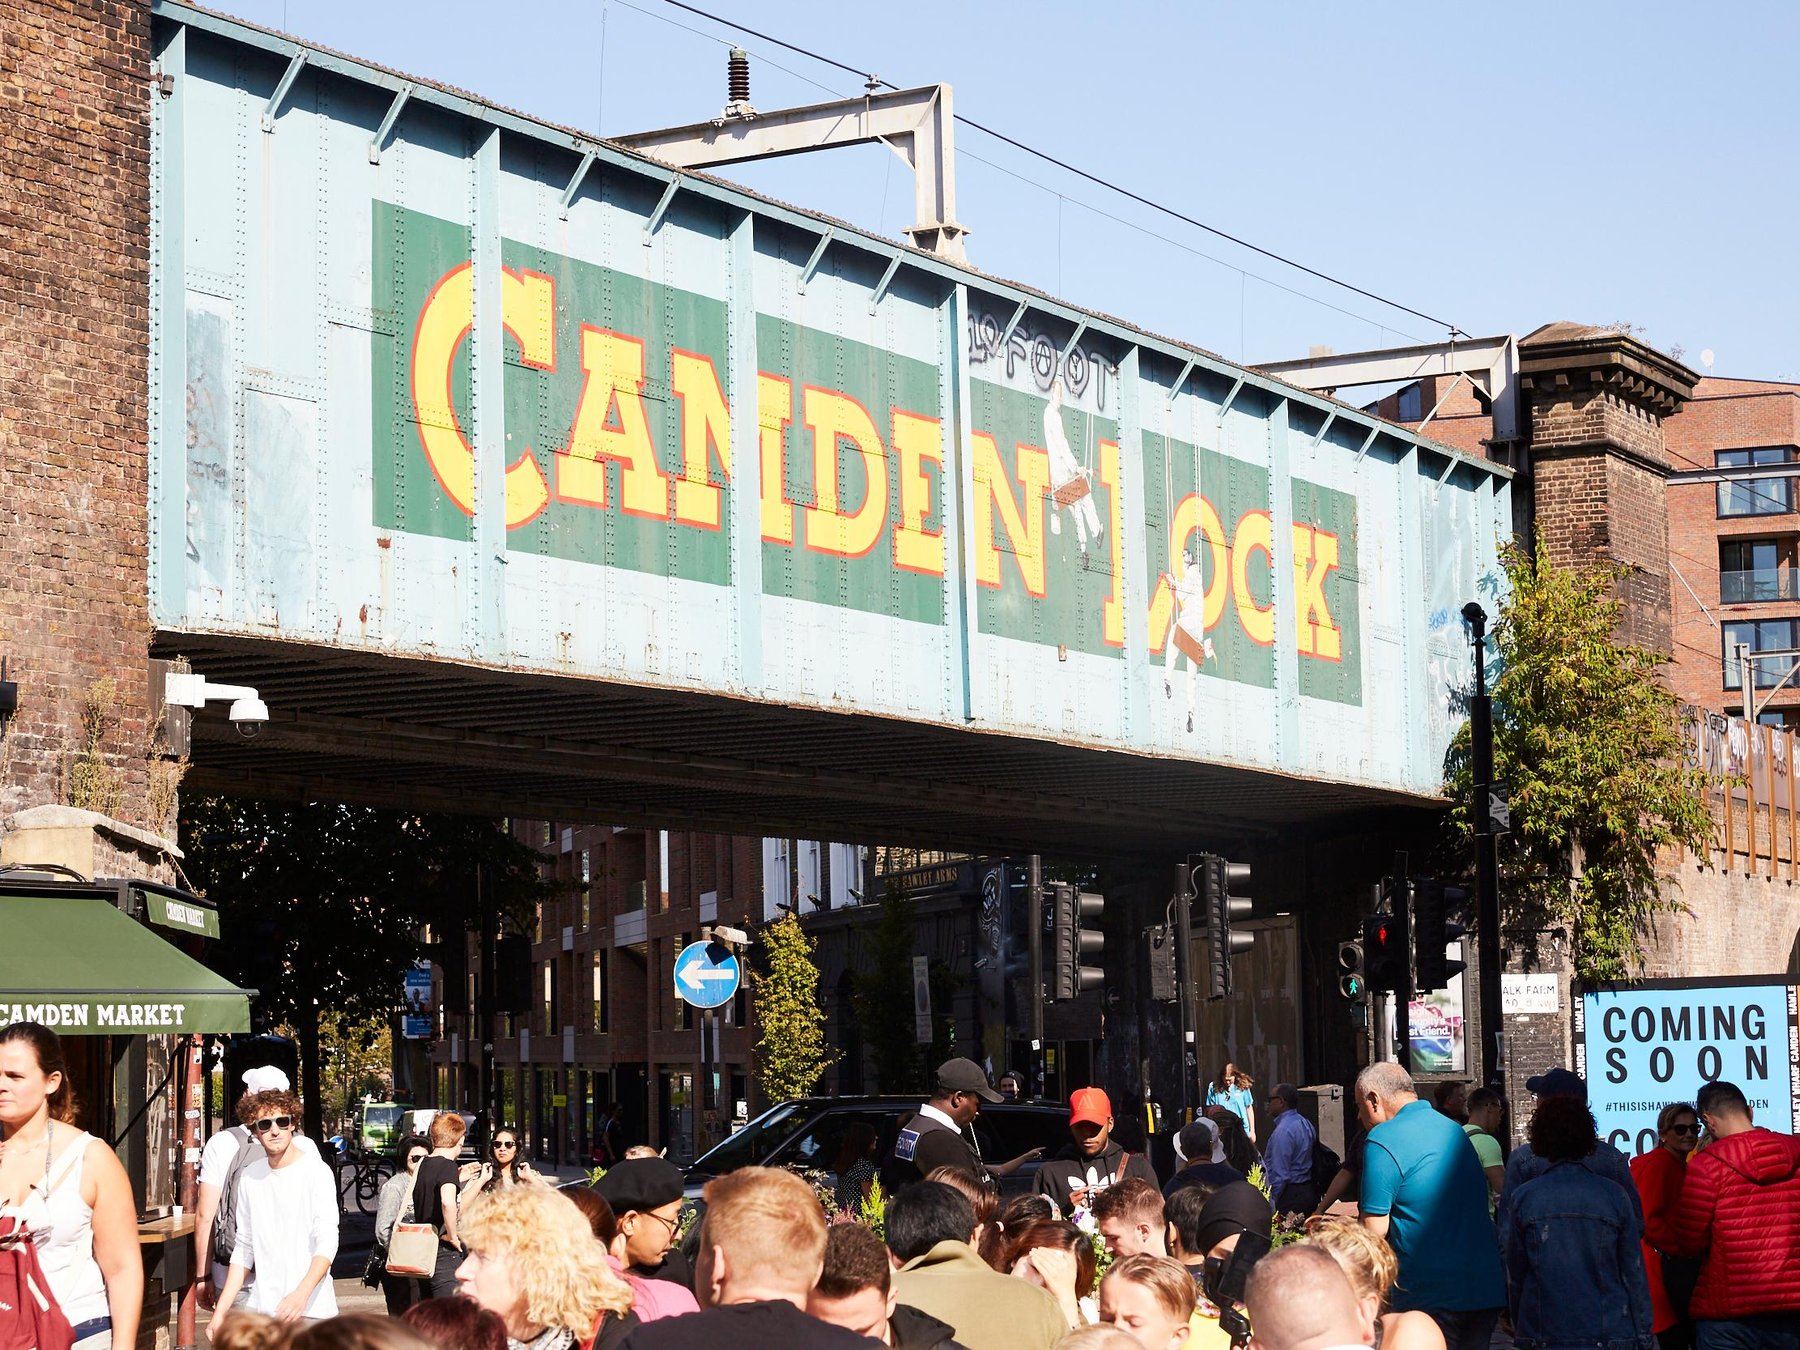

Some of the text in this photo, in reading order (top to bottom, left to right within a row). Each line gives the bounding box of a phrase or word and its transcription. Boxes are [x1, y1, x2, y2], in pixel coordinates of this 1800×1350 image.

[410, 260, 1051, 600] CAMDEN
[1099, 438, 1343, 663] LOCK
[935, 866, 958, 883] ARMS
[1502, 985, 1555, 996] ALK FARM
[1787, 985, 1797, 1015] HAWLE
[0, 1003, 186, 1027] CAMDEN MARKET
[1574, 996, 1584, 1033] HAWLEY
[1603, 1004, 1766, 1044] COMING
[1408, 1027, 1418, 1036] st
[1789, 1026, 1799, 1062] CAMDEN
[1605, 1045, 1769, 1084] SOON
